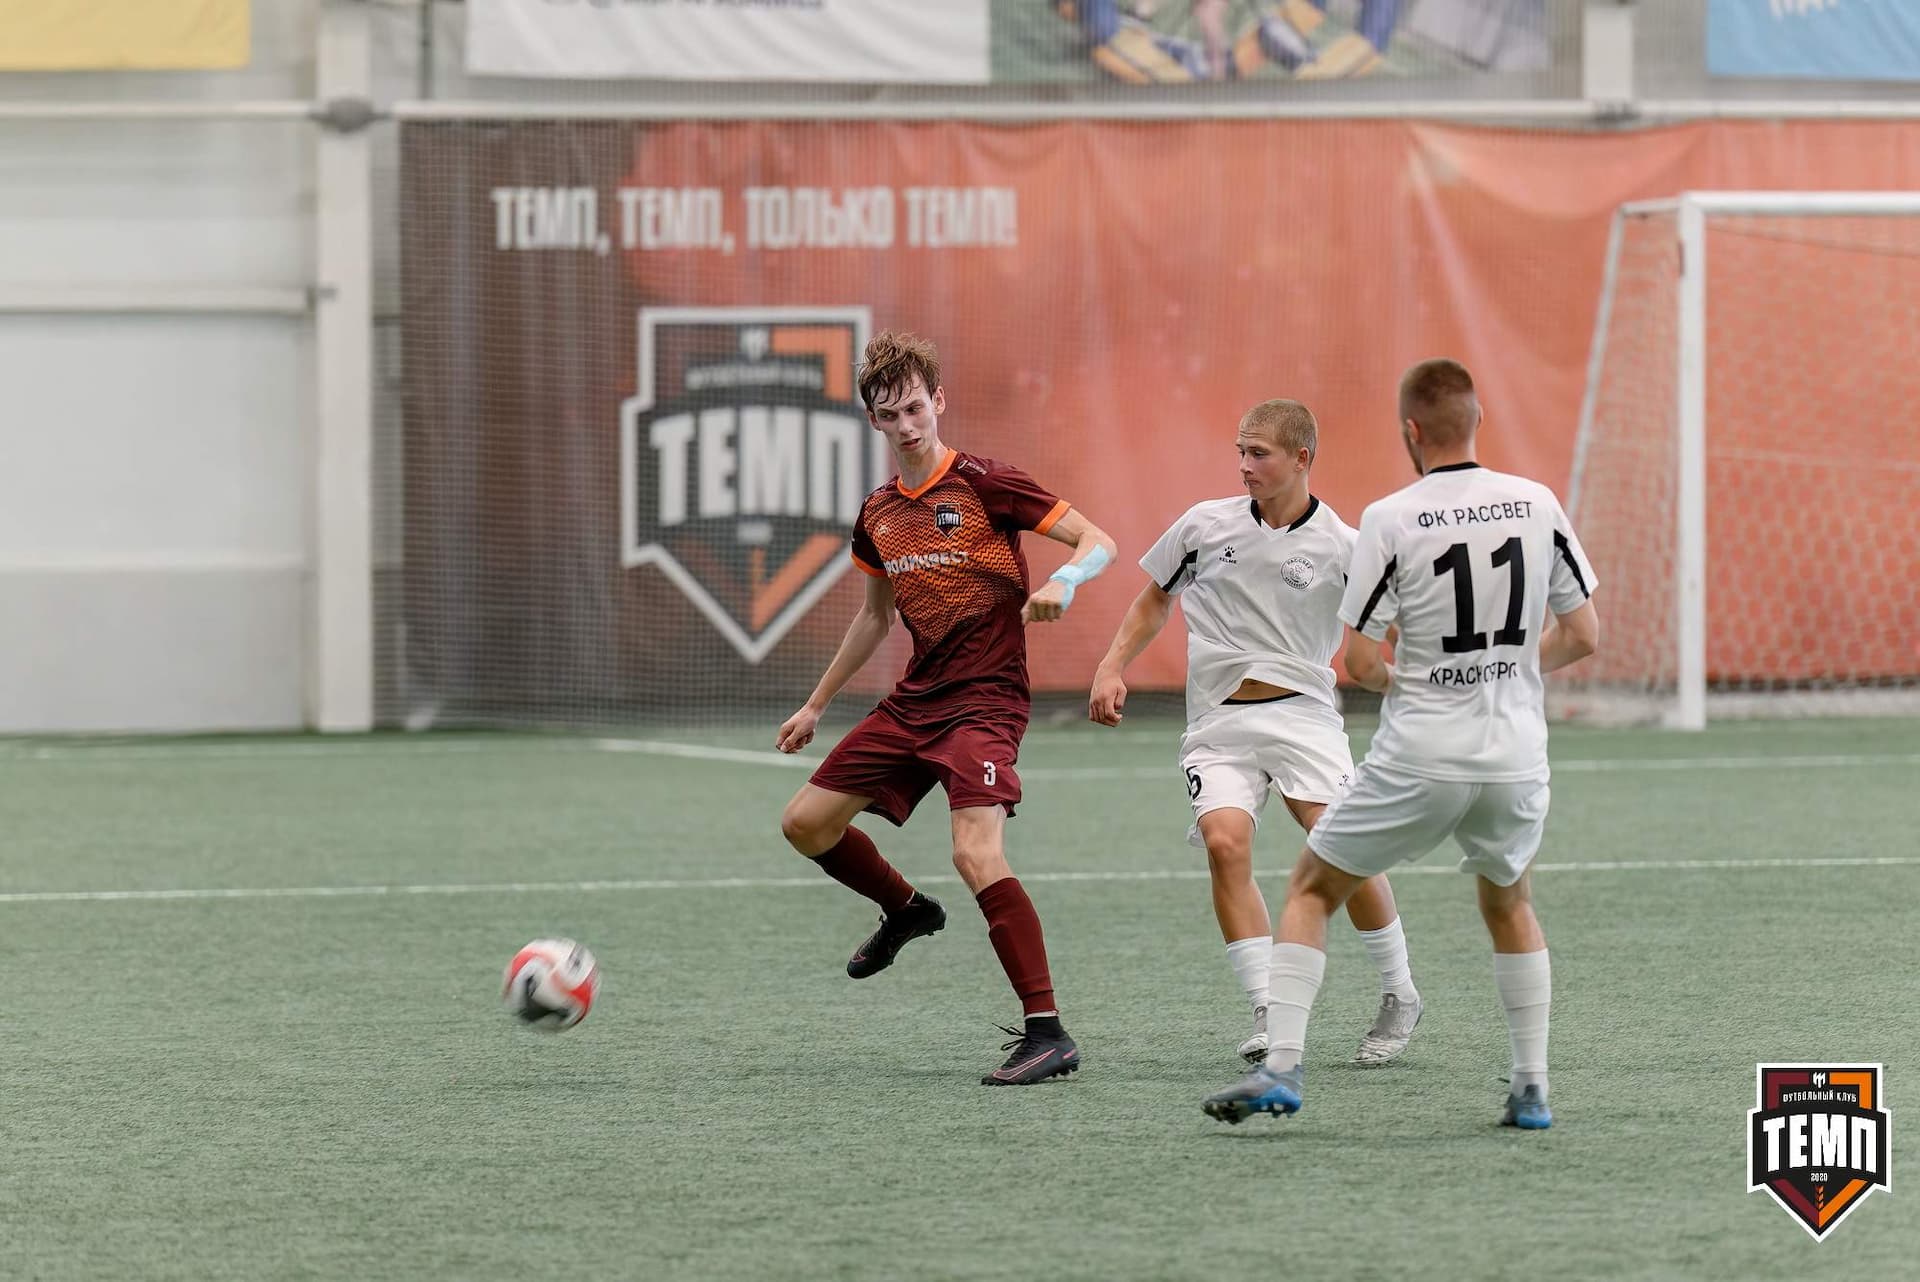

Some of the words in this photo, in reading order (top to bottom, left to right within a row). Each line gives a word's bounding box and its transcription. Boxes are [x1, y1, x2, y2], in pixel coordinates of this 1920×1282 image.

[491, 186, 610, 256] ТЕМП,
[617, 186, 735, 256] ТЕМП,
[742, 185, 896, 249] ТОЛЬКО
[904, 186, 1019, 248] ТЕМП!
[649, 405, 863, 527] ТЕМП
[1418, 511, 1448, 528] ФК
[1453, 501, 1531, 525] РАССВЕТ
[1433, 537, 1526, 653] 11
[983, 761, 996, 786] 3
